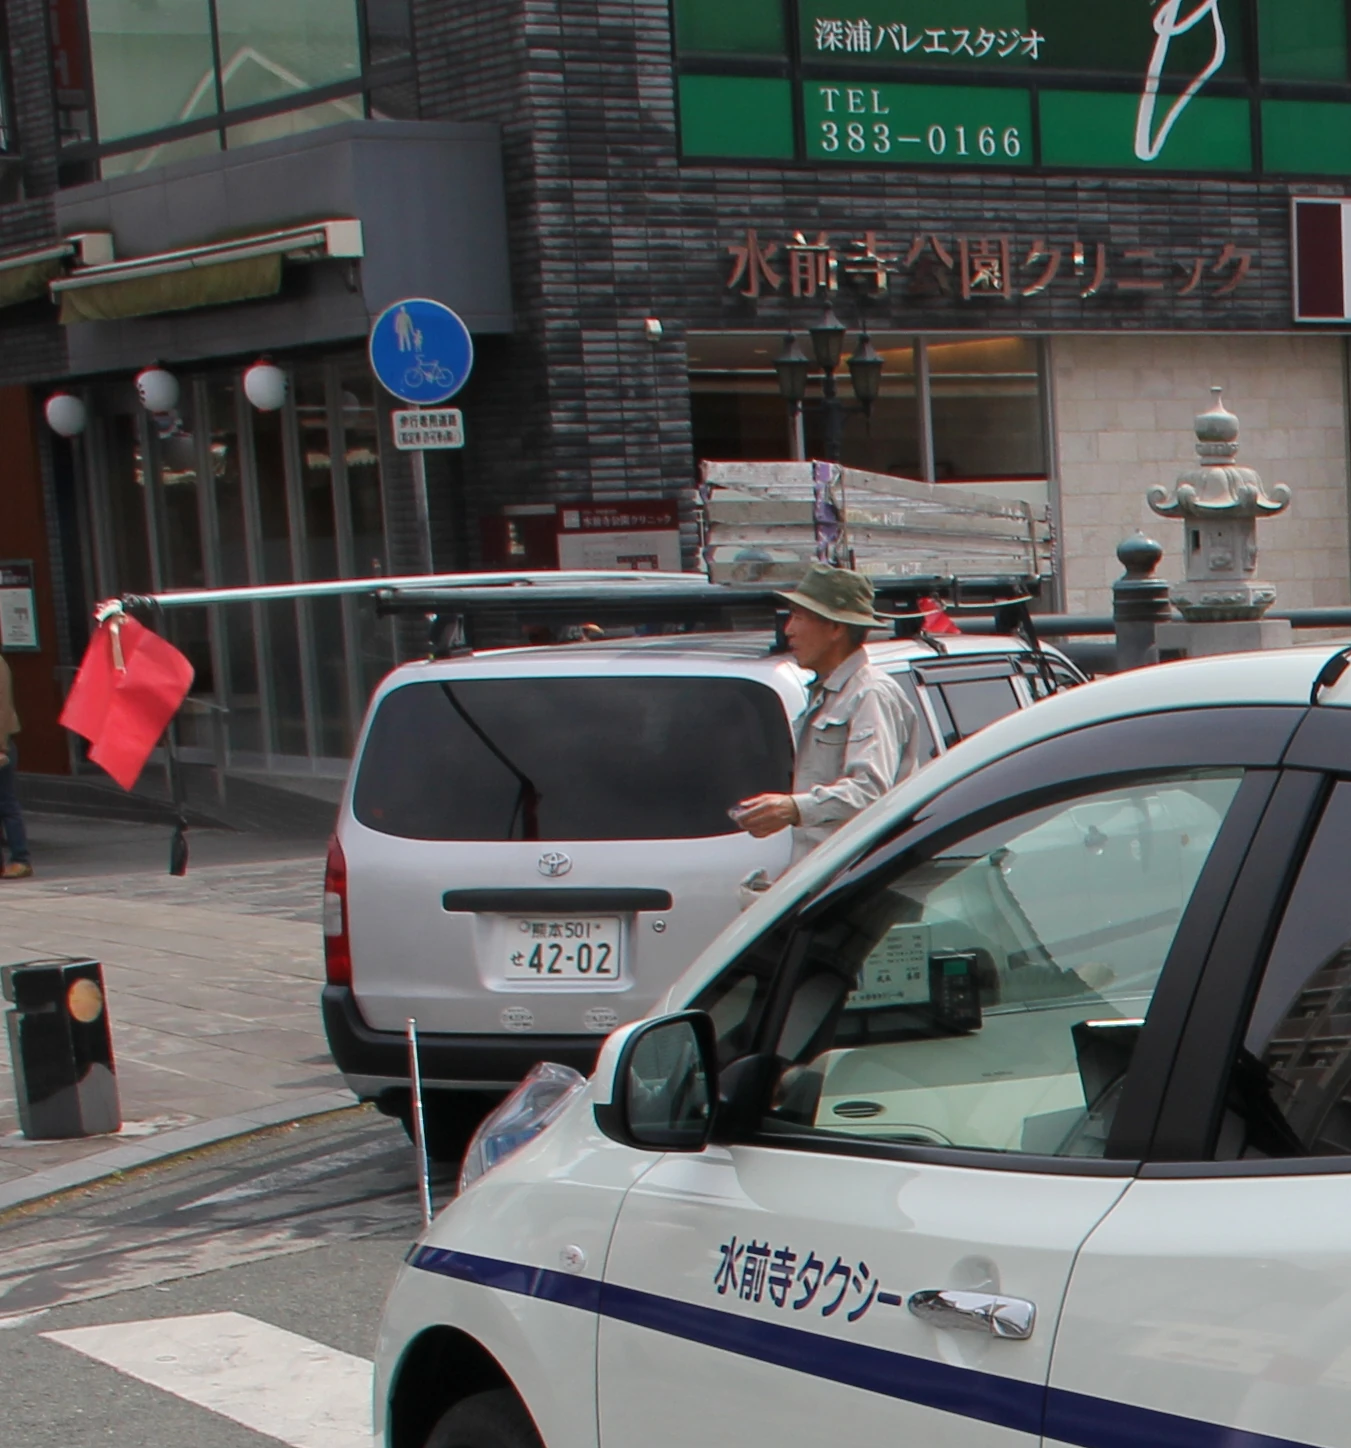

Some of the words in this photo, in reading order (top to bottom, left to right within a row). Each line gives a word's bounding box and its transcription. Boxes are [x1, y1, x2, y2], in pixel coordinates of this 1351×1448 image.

[814, 18, 1046, 61] 深浦バレエスタジオ
[819, 88, 891, 115] TEL
[820, 120, 1022, 158] 383-0166
[727, 229, 1254, 301] 水前寺公園クリニック
[510, 950, 525, 967] せ
[528, 942, 612, 974] 42-02
[713, 1235, 903, 1323] 水前寺タクシー
